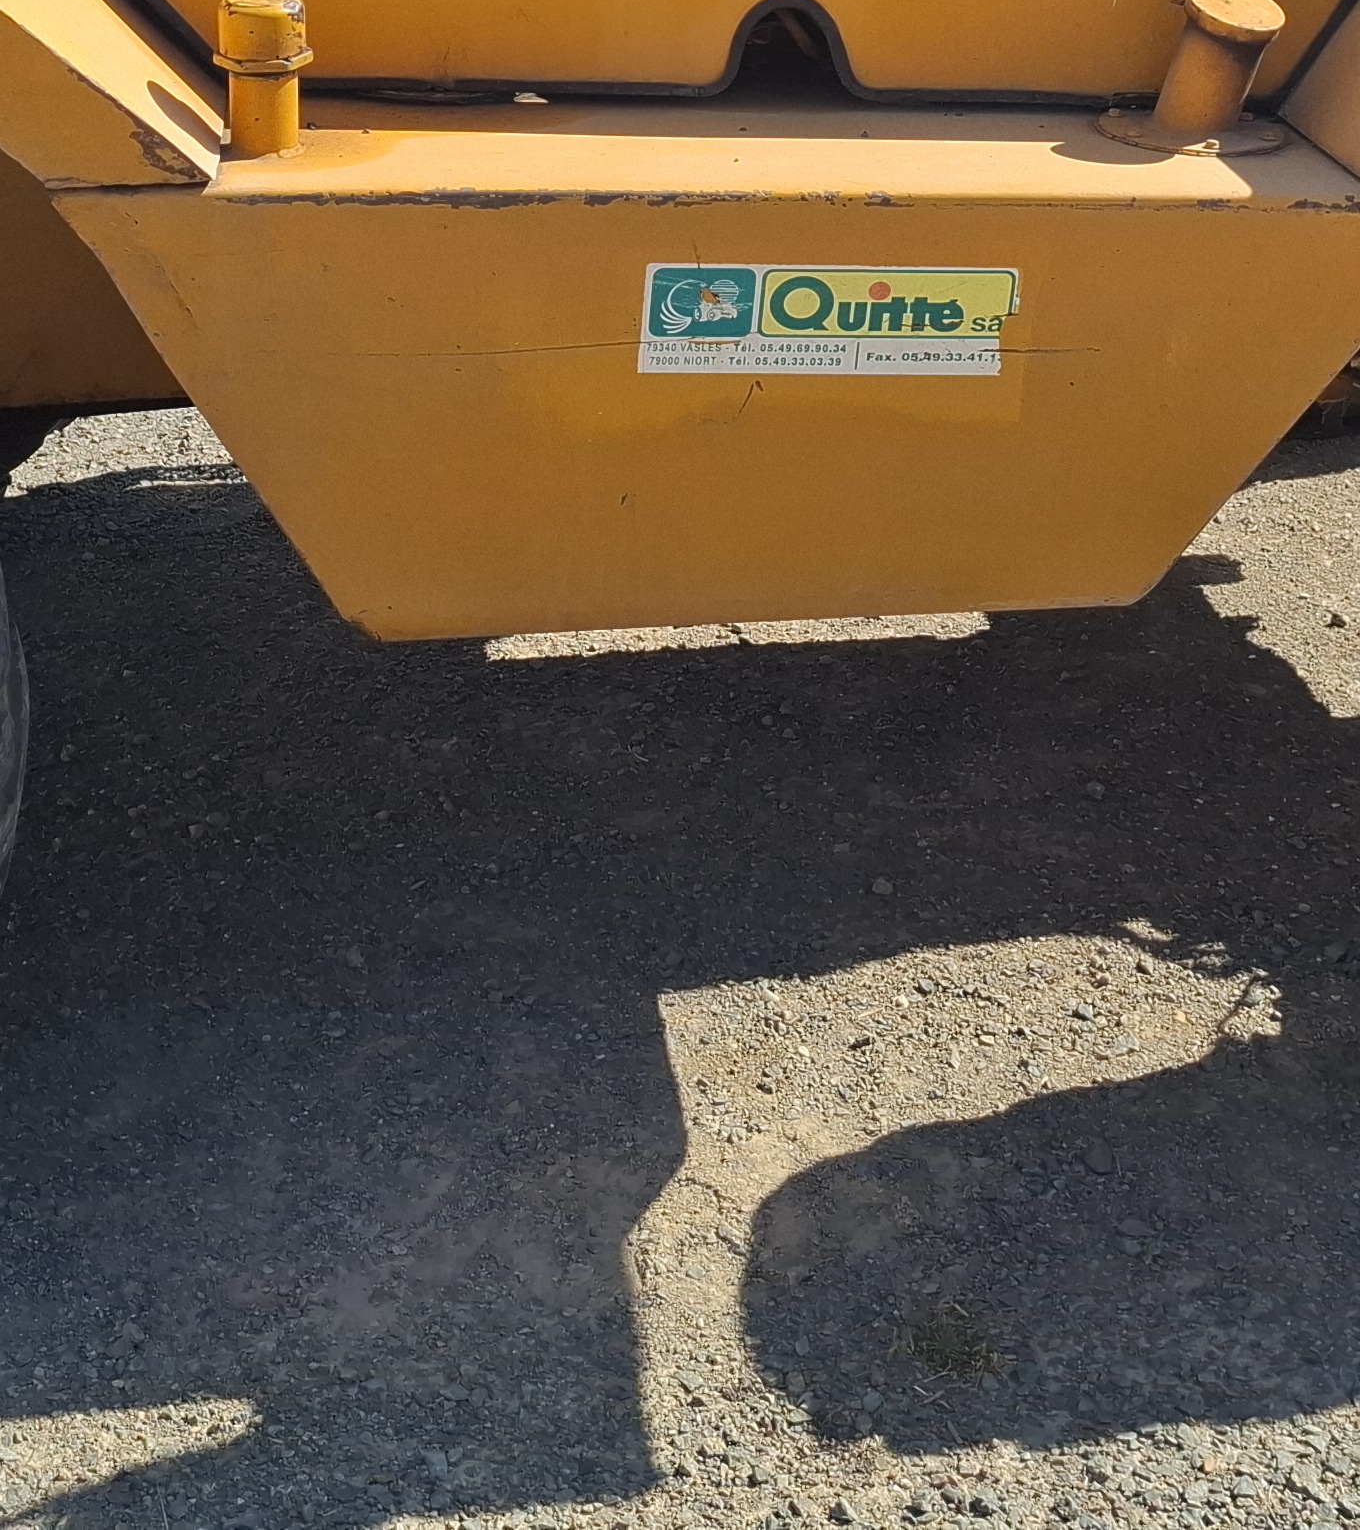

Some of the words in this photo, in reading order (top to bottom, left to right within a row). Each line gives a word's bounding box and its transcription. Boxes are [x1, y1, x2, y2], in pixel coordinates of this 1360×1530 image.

[680, 342, 722, 353] VASLES
[648, 356, 680, 366] 79000
[683, 356, 718, 366] NIORT
[866, 352, 897, 362] Fax.
